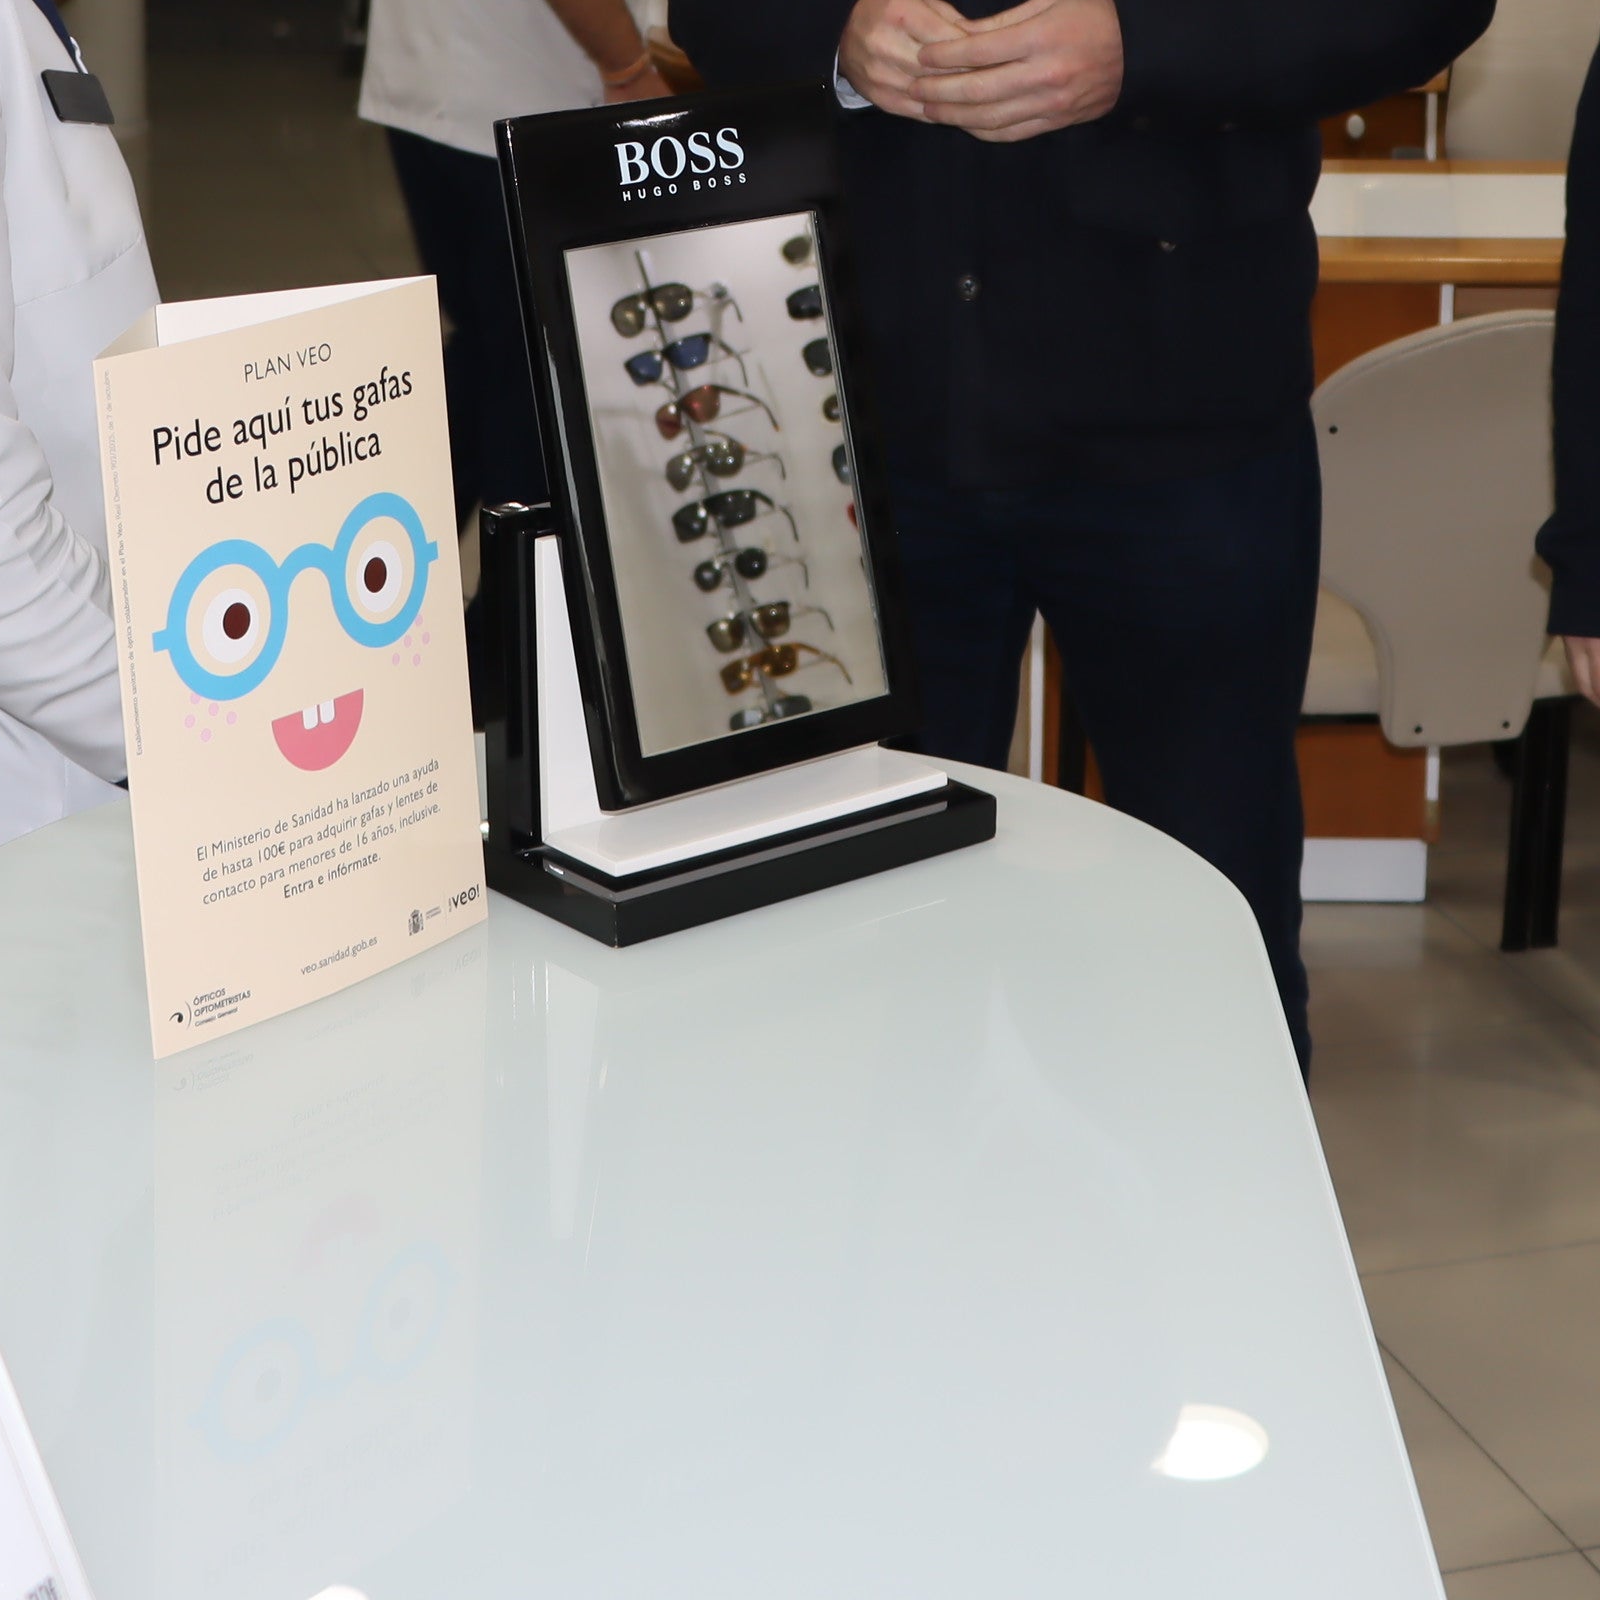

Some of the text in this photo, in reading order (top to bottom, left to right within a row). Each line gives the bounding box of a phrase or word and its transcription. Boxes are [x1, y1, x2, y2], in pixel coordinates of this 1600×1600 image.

[614, 127, 745, 186] BOSS
[622, 172, 747, 202] HUGO BOSS
[244, 343, 332, 383] PLAN VEO
[152, 365, 413, 466] Pide aquí tus gafas
[205, 431, 383, 505] de la pública
[196, 758, 440, 862] El Ministerio de Sanidad ha lanzado una ayuda
[202, 781, 439, 883] de hasta 100€ para adquirir gafas y lentes de
[202, 802, 441, 905] contacto para menores de 16 años, inclusive.
[283, 852, 381, 899] Entra e infórmate.
[300, 936, 378, 975] veo.sanidad.gob.es
[193, 988, 226, 1006] ÓPTICOS
[194, 990, 251, 1017] OPTOMETRISTAS
